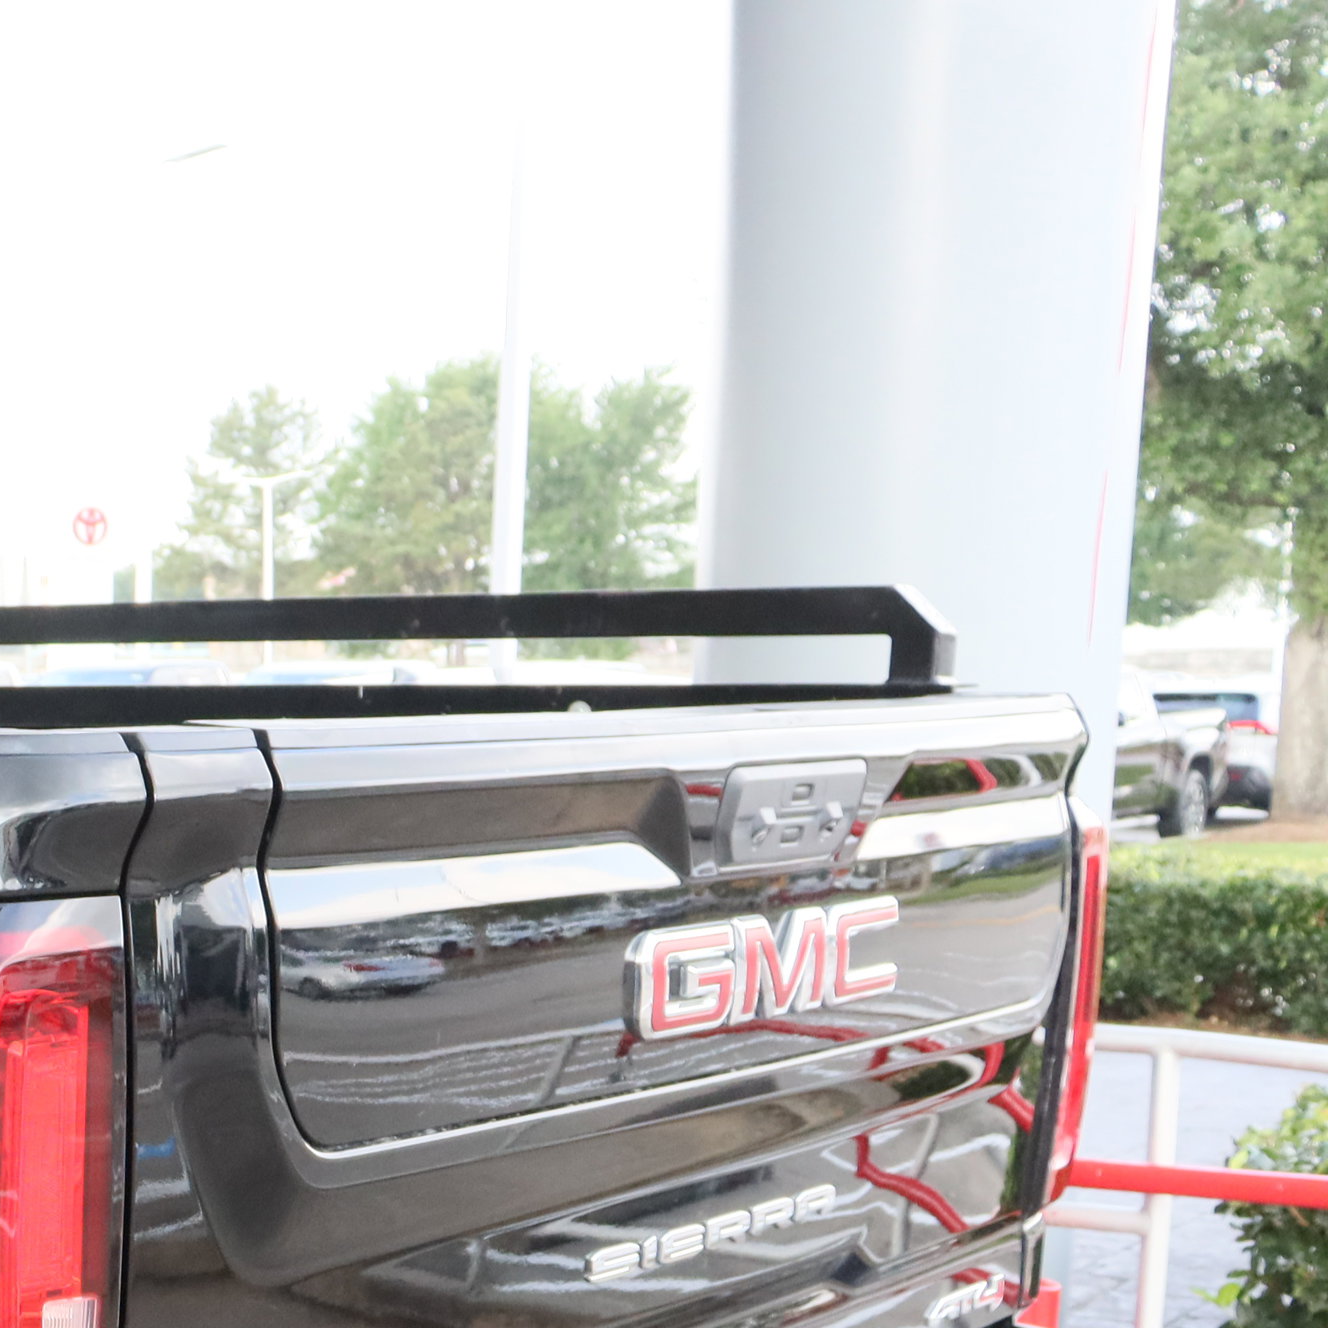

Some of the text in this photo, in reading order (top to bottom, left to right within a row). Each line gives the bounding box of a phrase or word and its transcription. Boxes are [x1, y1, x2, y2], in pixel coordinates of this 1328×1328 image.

[623, 895, 899, 1040] GMC
[584, 1183, 836, 1283] SIERRA
[924, 1273, 1005, 1322] AT4
